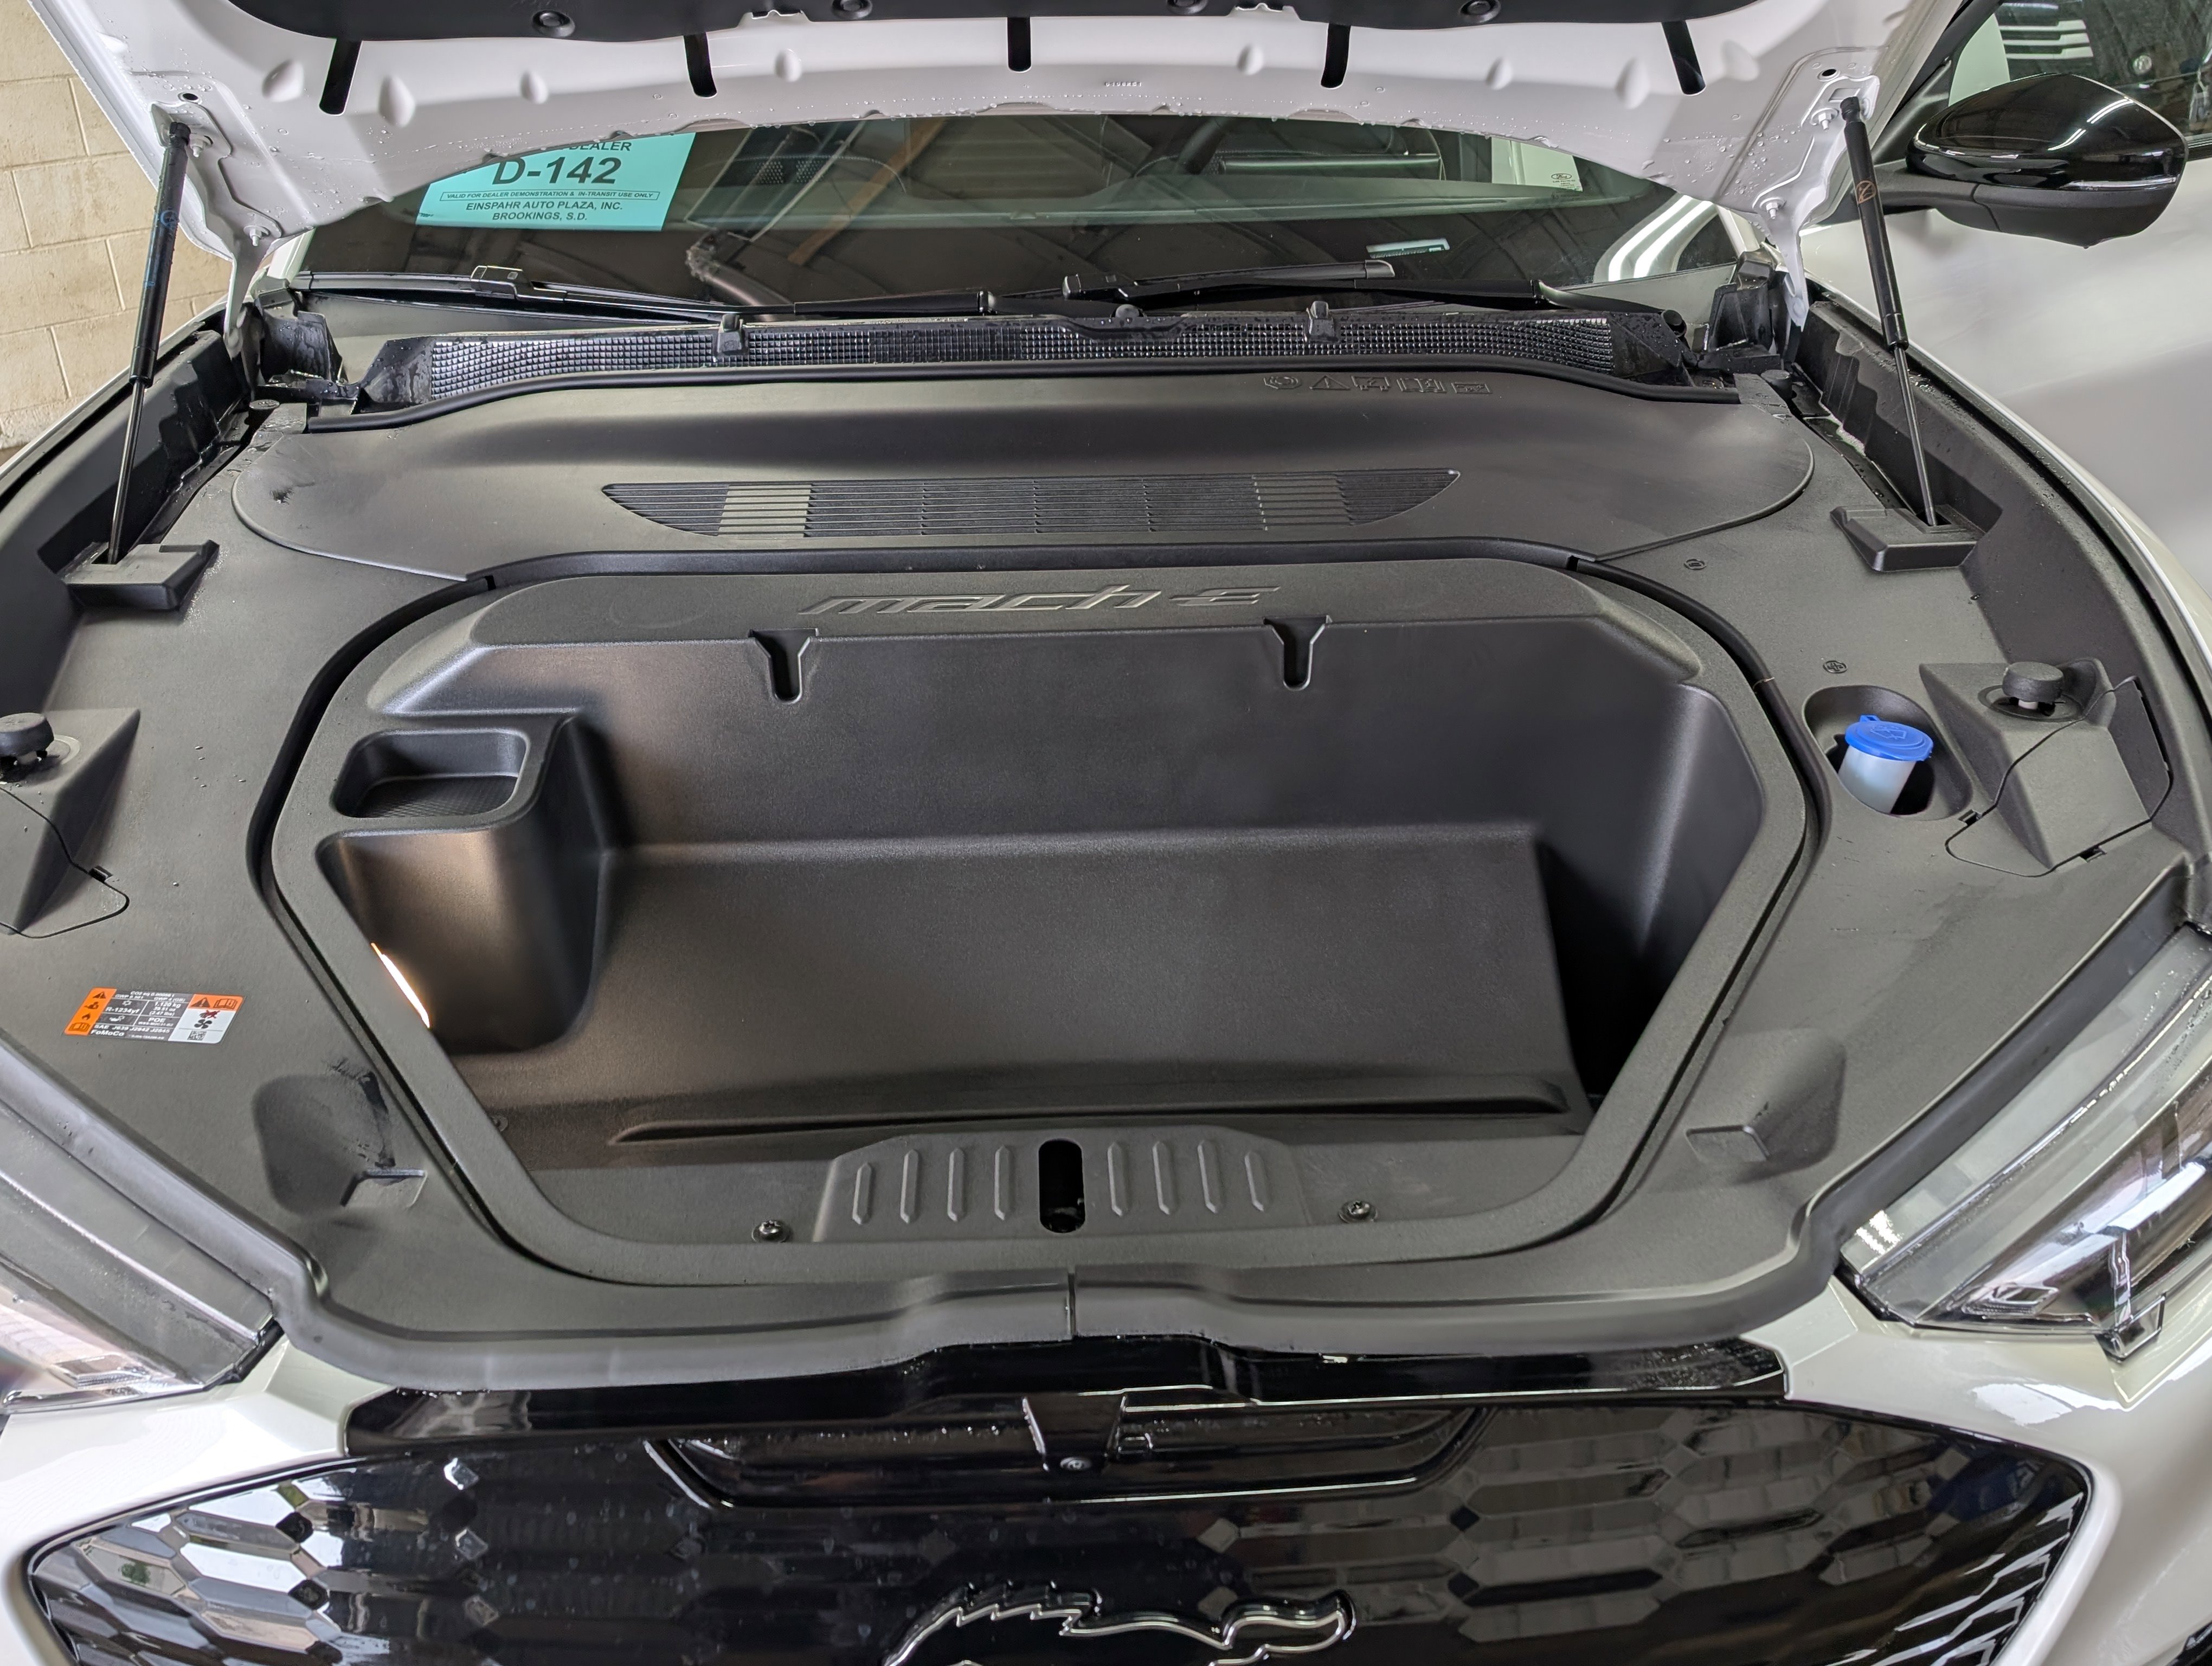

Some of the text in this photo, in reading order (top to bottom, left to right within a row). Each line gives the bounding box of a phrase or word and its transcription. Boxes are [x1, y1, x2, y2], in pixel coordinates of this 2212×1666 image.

[492, 156, 622, 184] D-142
[466, 201, 623, 210] EINSPAHR AUTO PLAZA, INC.
[492, 212, 587, 221] BROOKINGS, S.D.
[105, 1006, 140, 1015] R-1234yf
